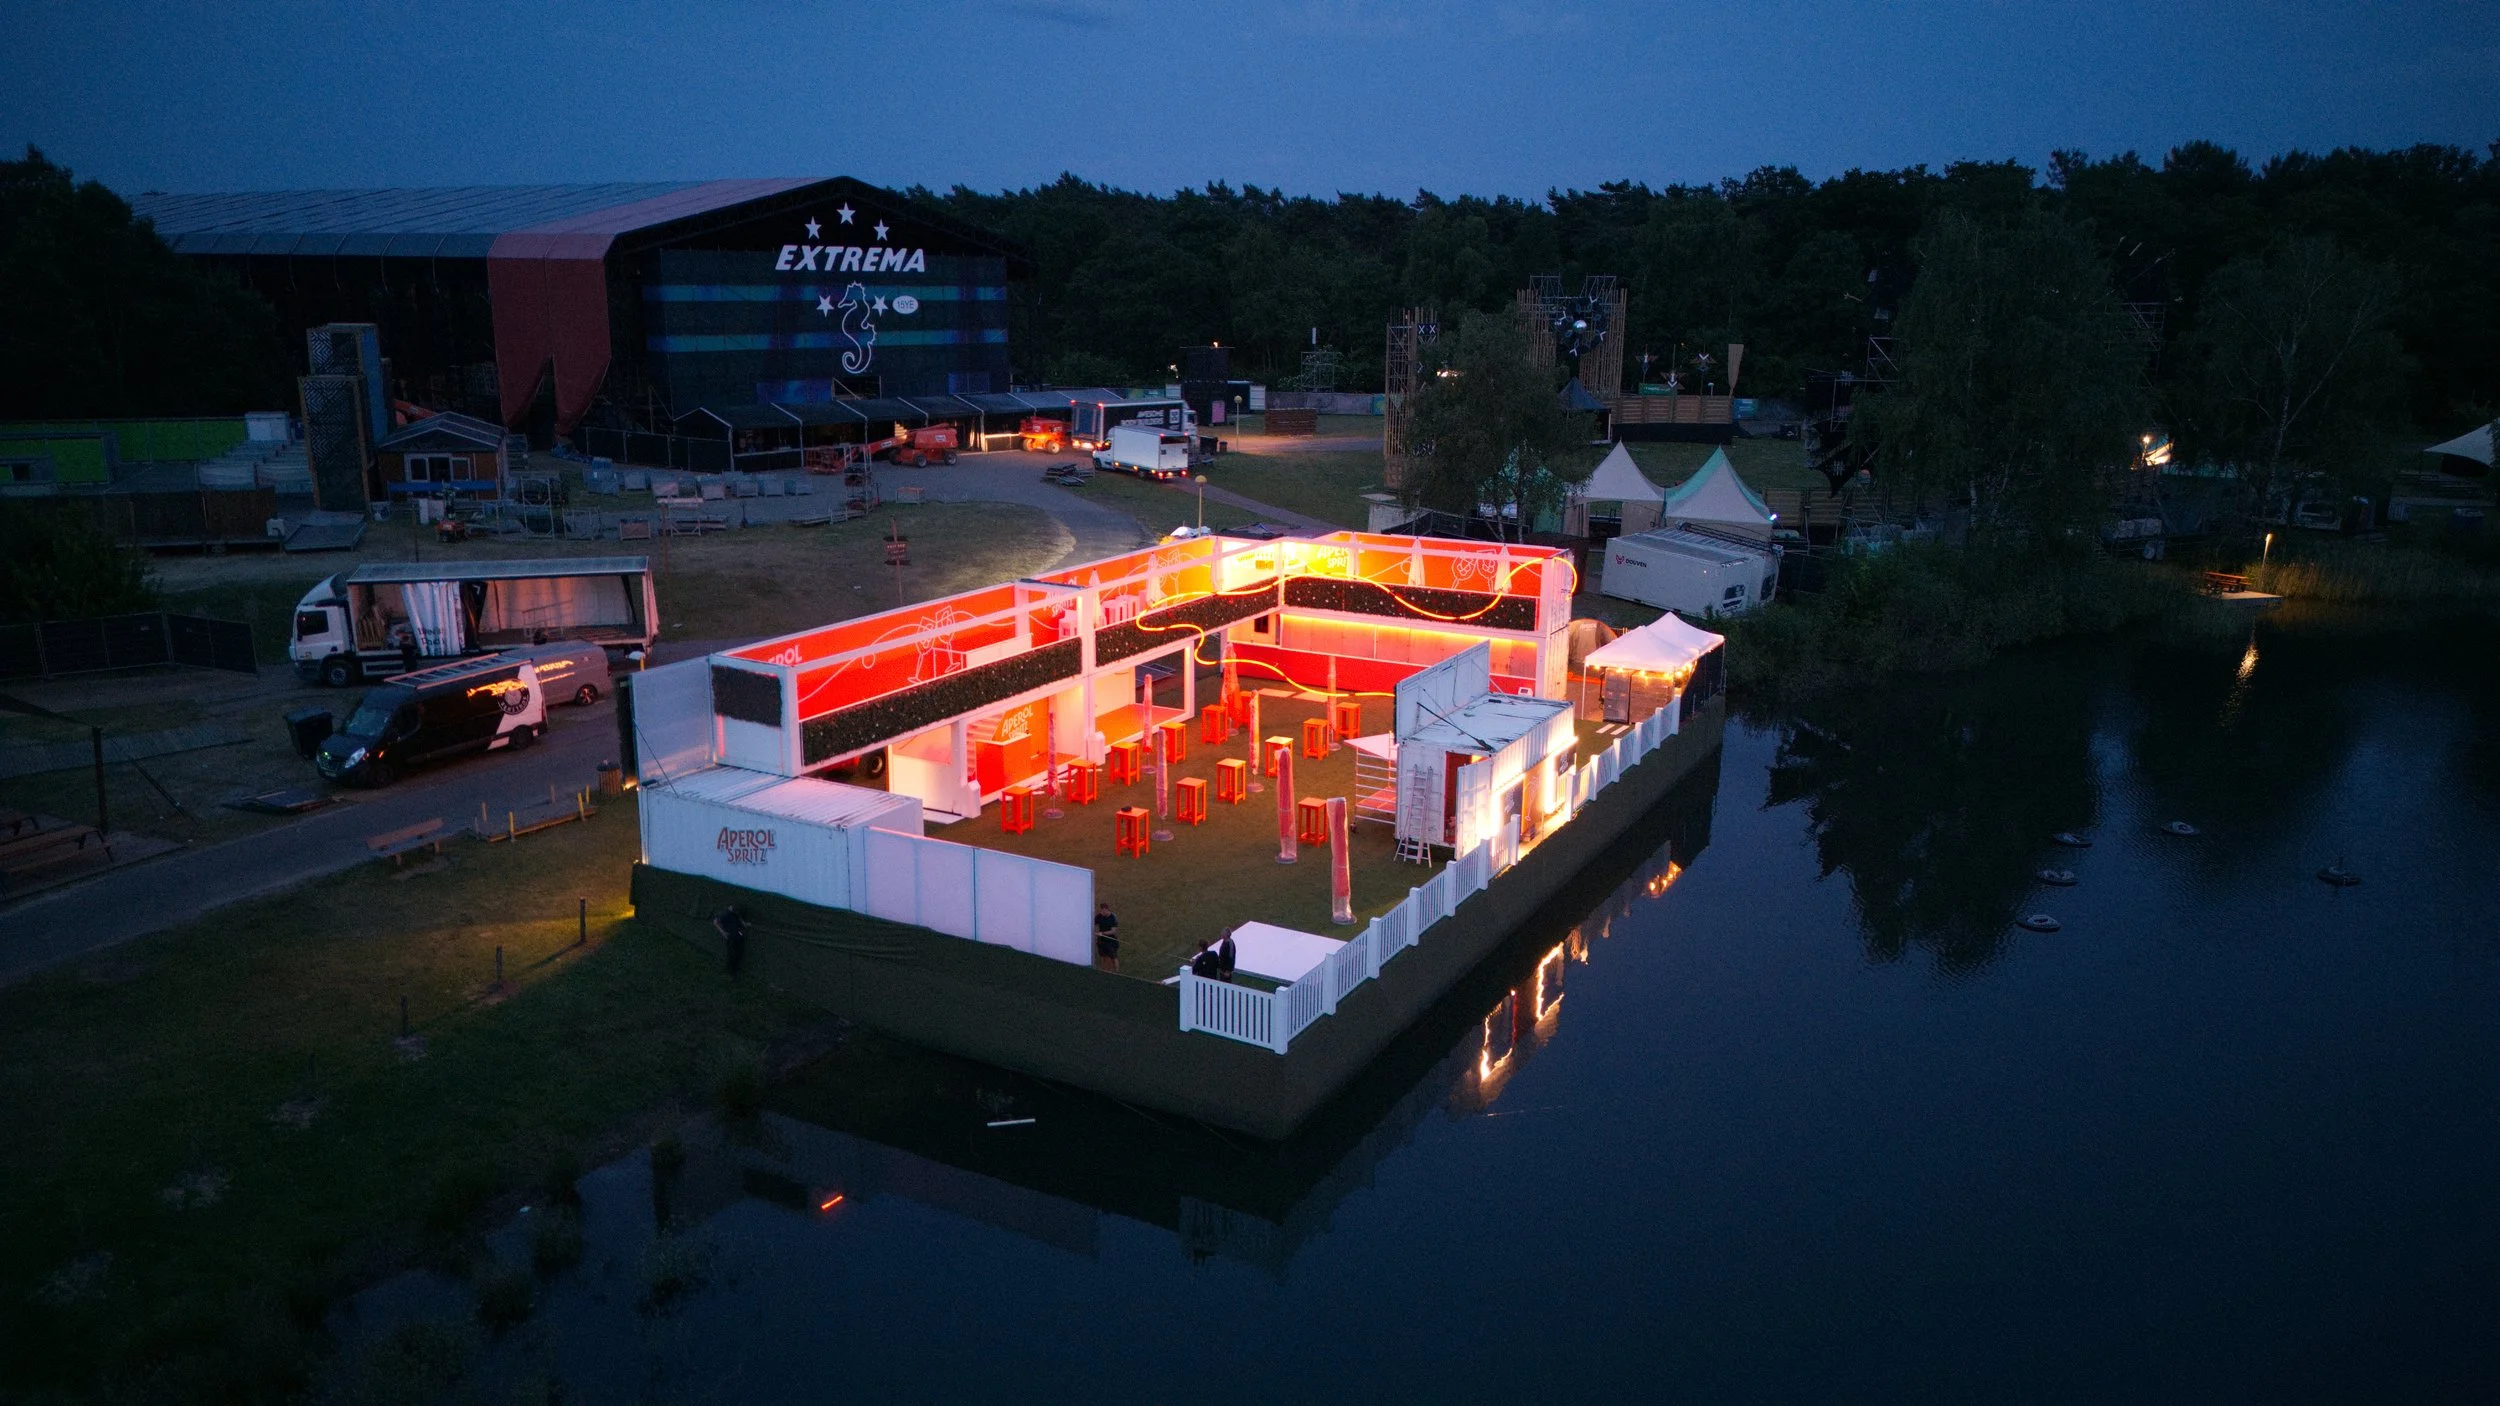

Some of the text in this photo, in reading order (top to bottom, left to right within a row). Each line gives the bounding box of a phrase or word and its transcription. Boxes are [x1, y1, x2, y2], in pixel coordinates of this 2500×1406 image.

[775, 244, 925, 272] EXTREMA
[1001, 704, 1034, 738] APEROL
[717, 826, 775, 850] APEROL
[727, 847, 767, 863] SPRITZ
